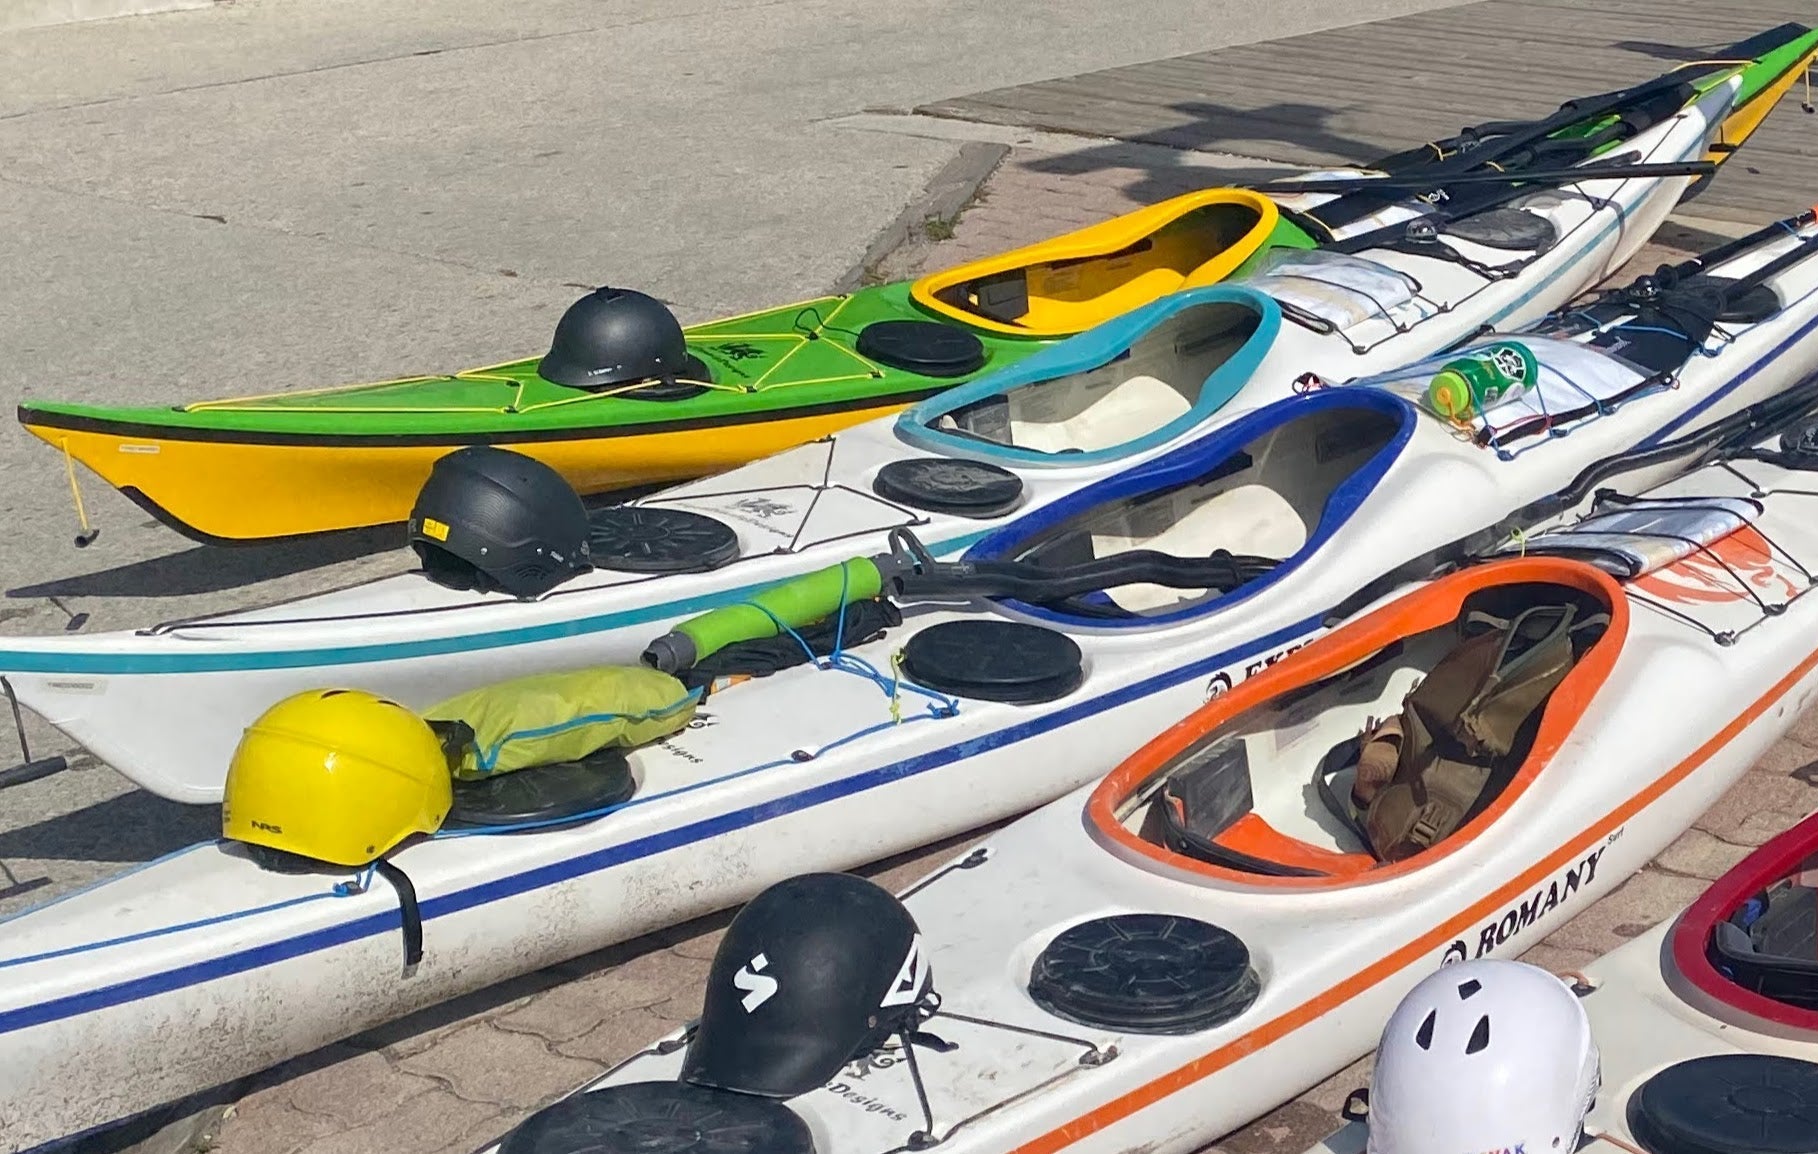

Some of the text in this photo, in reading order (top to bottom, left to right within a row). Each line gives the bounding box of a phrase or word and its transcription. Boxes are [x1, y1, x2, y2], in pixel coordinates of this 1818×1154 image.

[251, 820, 283, 834] NRS
[1475, 845, 1606, 959] ROMANY
[828, 1082, 908, 1121] Designs
